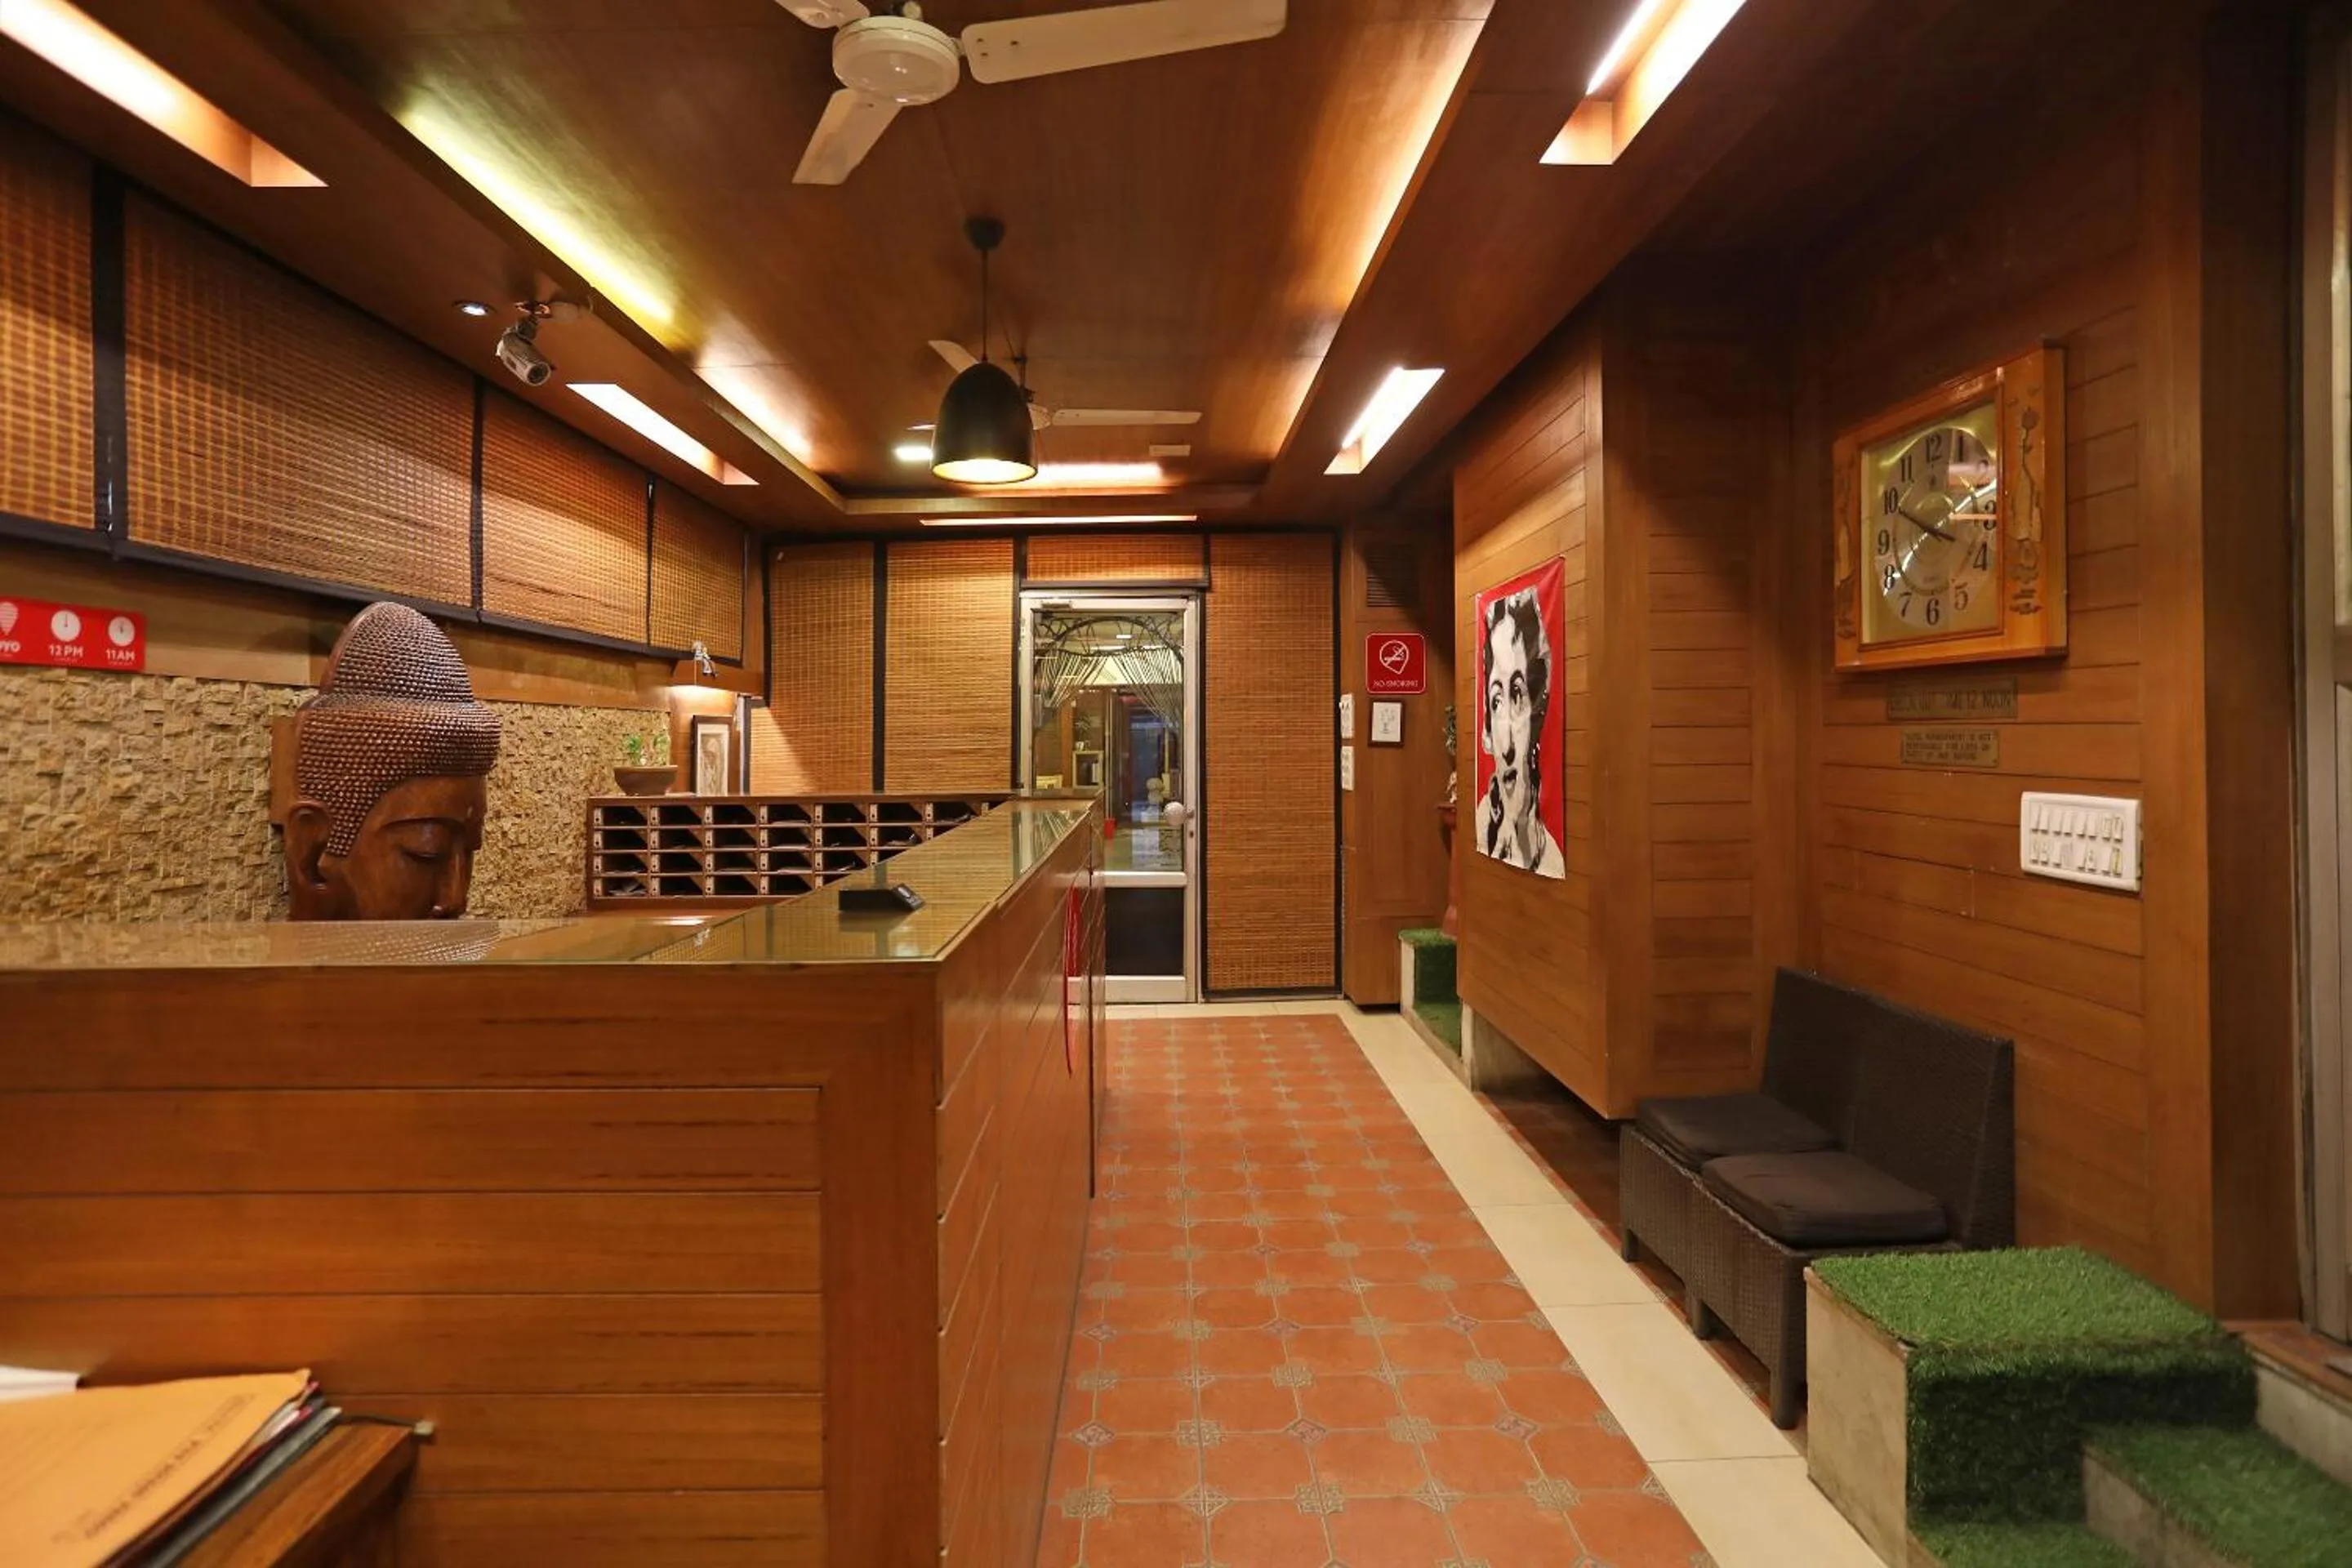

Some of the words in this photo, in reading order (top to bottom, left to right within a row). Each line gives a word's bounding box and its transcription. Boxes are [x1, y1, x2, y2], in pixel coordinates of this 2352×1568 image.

[1926, 434, 1942, 464] 12
[1900, 455, 1914, 483] 11
[1884, 487, 1898, 514] 10
[1984, 500, 1997, 530] 3
[1878, 530, 1890, 555] 9
[1973, 541, 1988, 572] 4
[1884, 564, 1895, 590] 8
[1899, 592, 1912, 617] 7
[1954, 582, 1968, 611] 5
[1926, 598, 1940, 626] 6
[0, 640, 20, 653] YO
[49, 644, 62, 656] 12
[64, 644, 83, 657] PM
[106, 649, 116, 660] 11
[117, 650, 135, 661] AM
